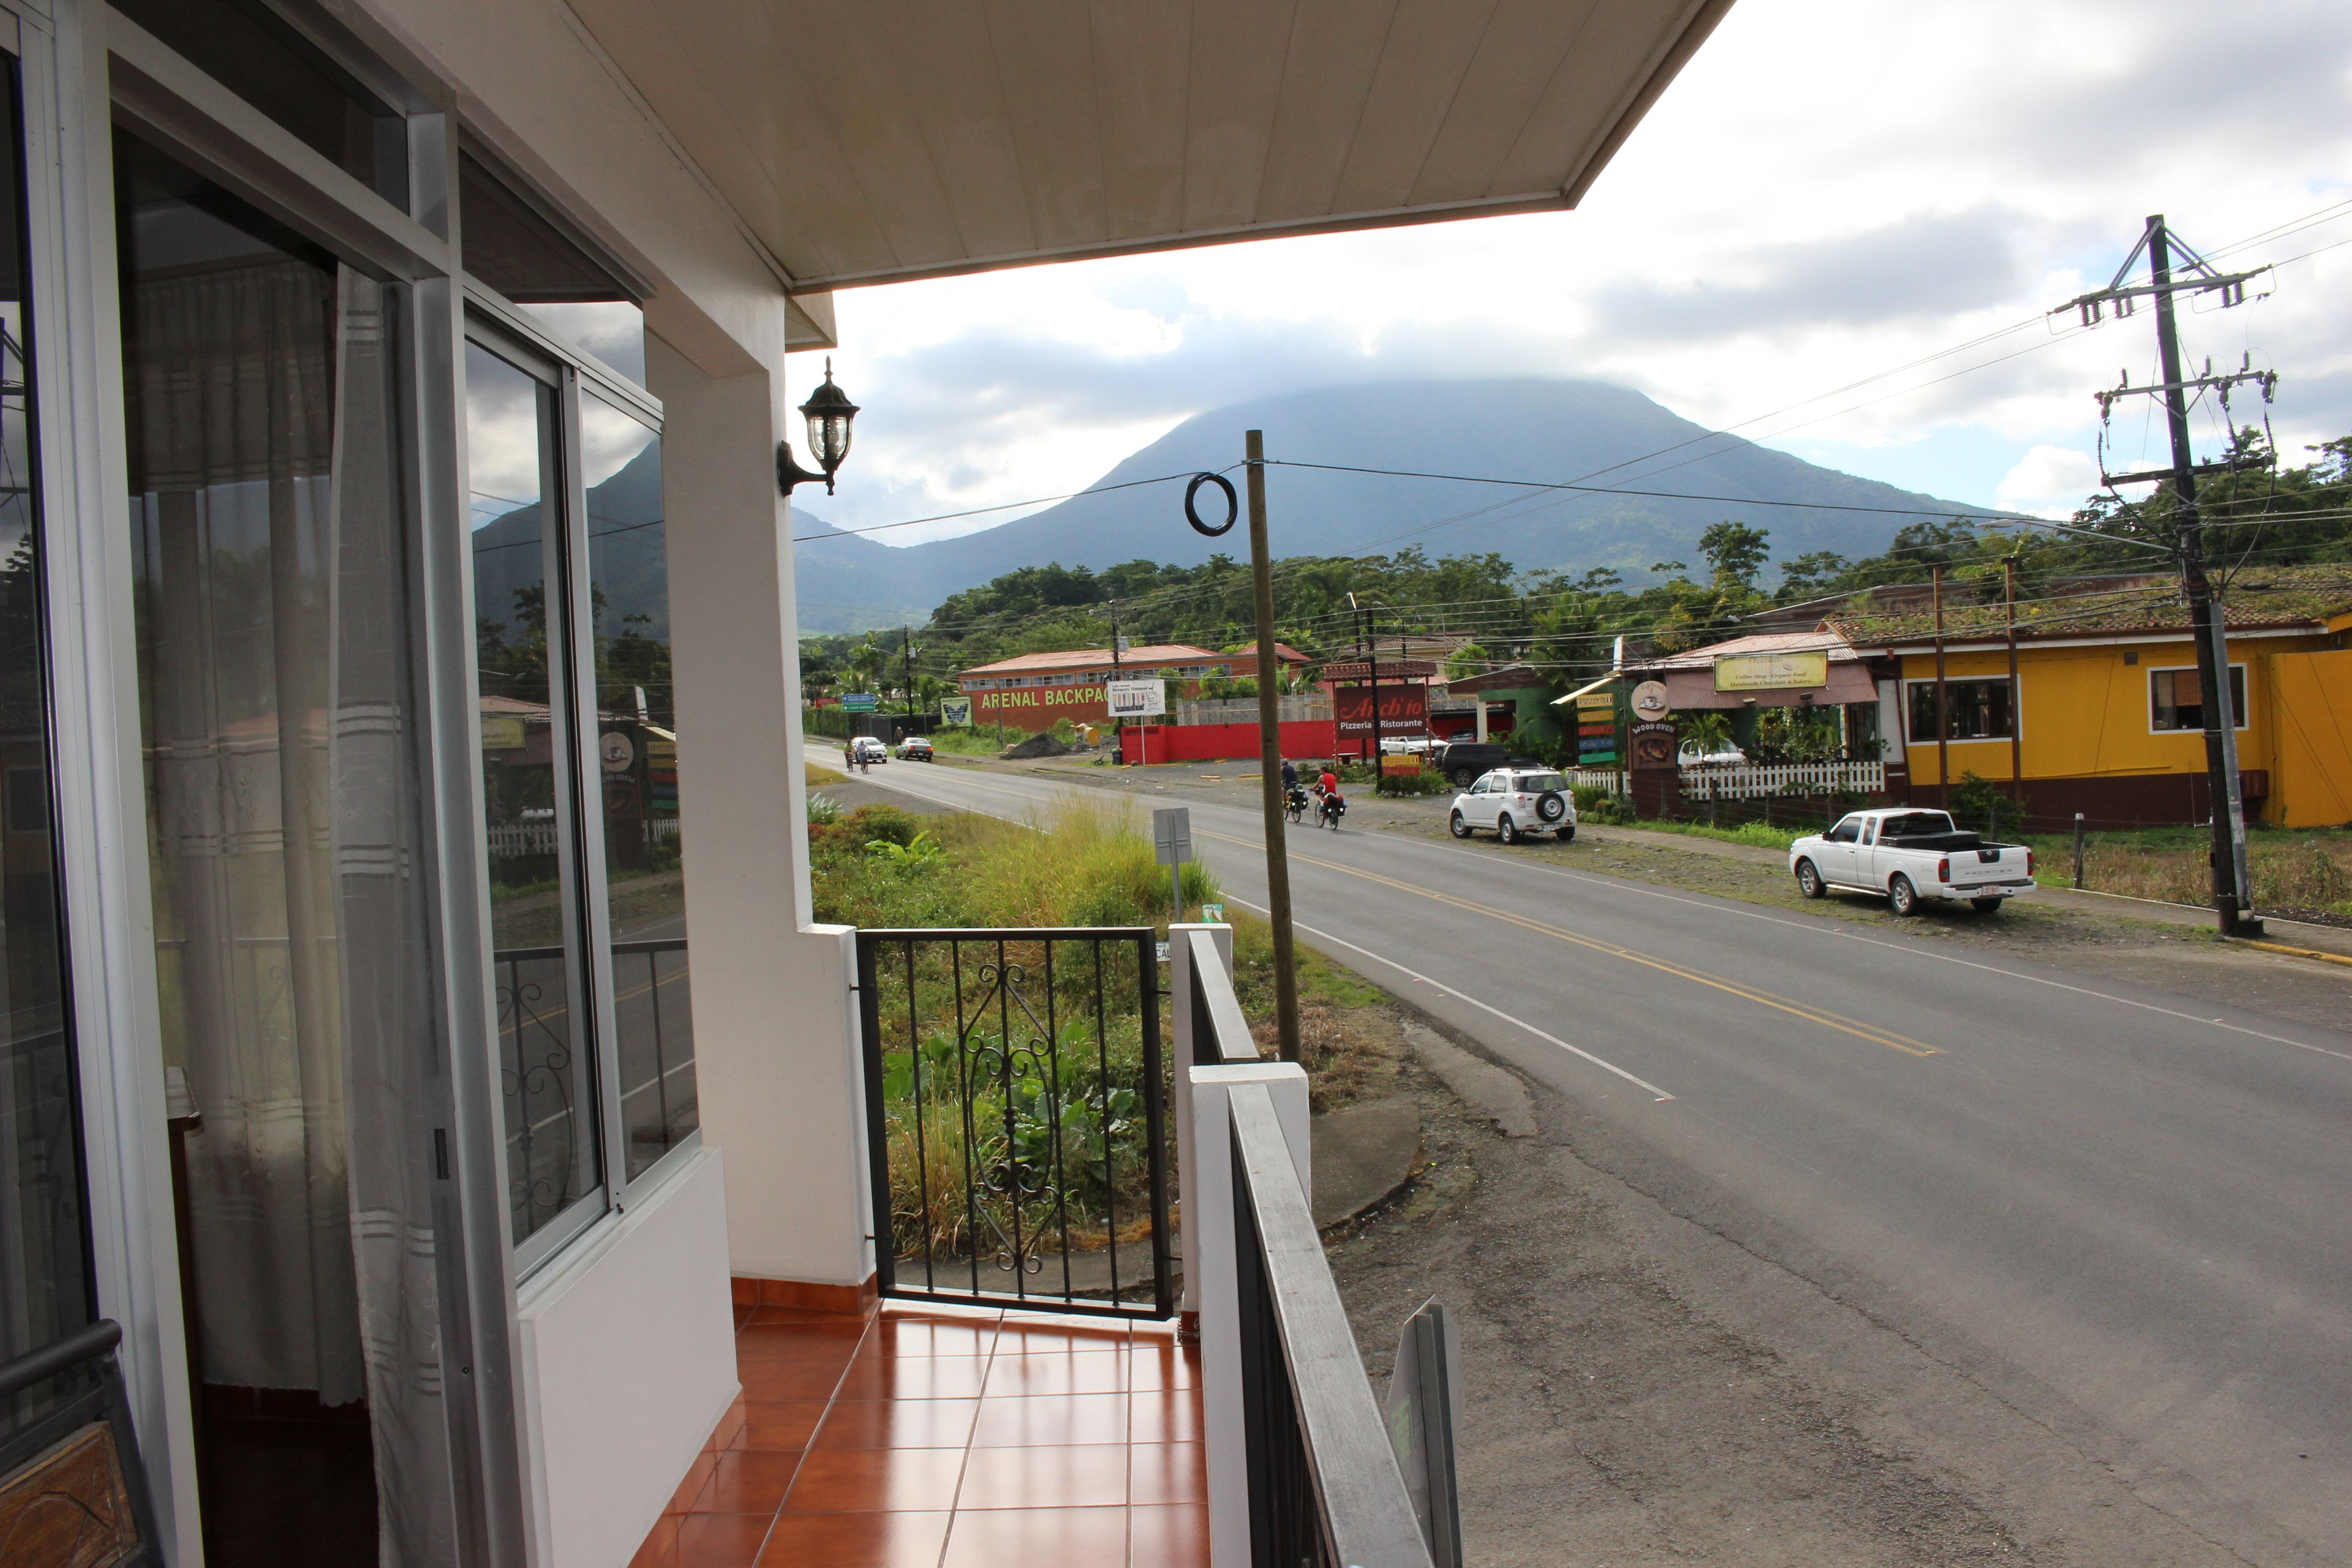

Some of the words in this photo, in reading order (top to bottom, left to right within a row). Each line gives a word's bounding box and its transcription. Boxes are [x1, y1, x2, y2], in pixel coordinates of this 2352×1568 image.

[981, 691, 1039, 709] ARENAL
[1340, 721, 1372, 730] Pizzeria
[1381, 720, 1422, 728] Ristorante
[1632, 723, 1654, 734] WOOD
[1656, 723, 1675, 734] OVEN
